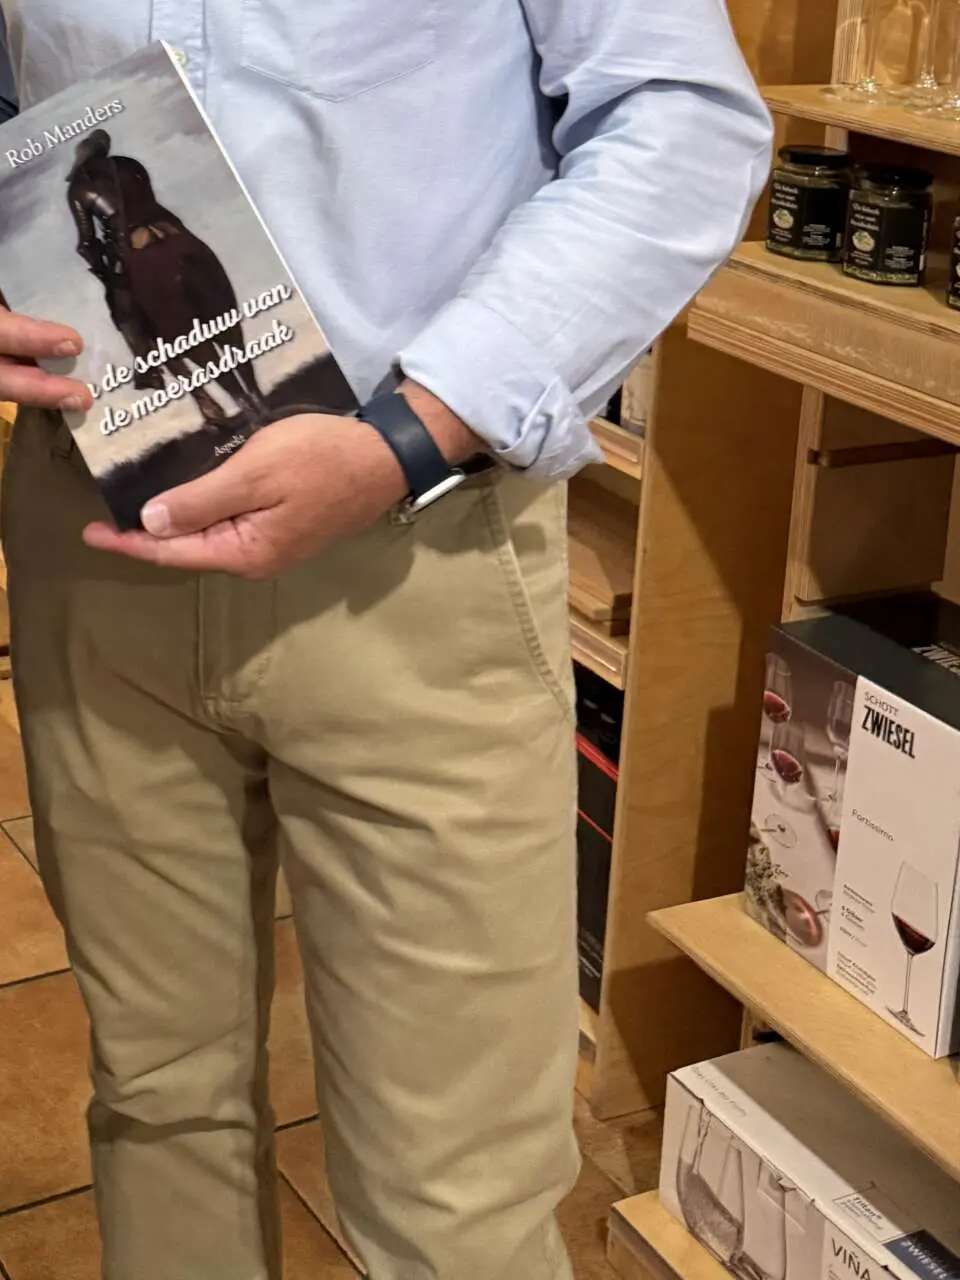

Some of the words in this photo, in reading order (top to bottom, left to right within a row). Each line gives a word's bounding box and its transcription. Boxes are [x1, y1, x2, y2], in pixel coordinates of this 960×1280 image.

[5, 138, 43, 168] Rob
[43, 100, 123, 149] Manders
[102, 364, 132, 392] de
[134, 308, 242, 374] schaduw
[242, 284, 290, 318] van
[100, 406, 132, 435] de
[131, 320, 293, 421] moerasdraak
[861, 704, 915, 759] ZWIESEL
[864, 691, 899, 717] SCHOTT
[831, 1237, 871, 1280] VIÑA
